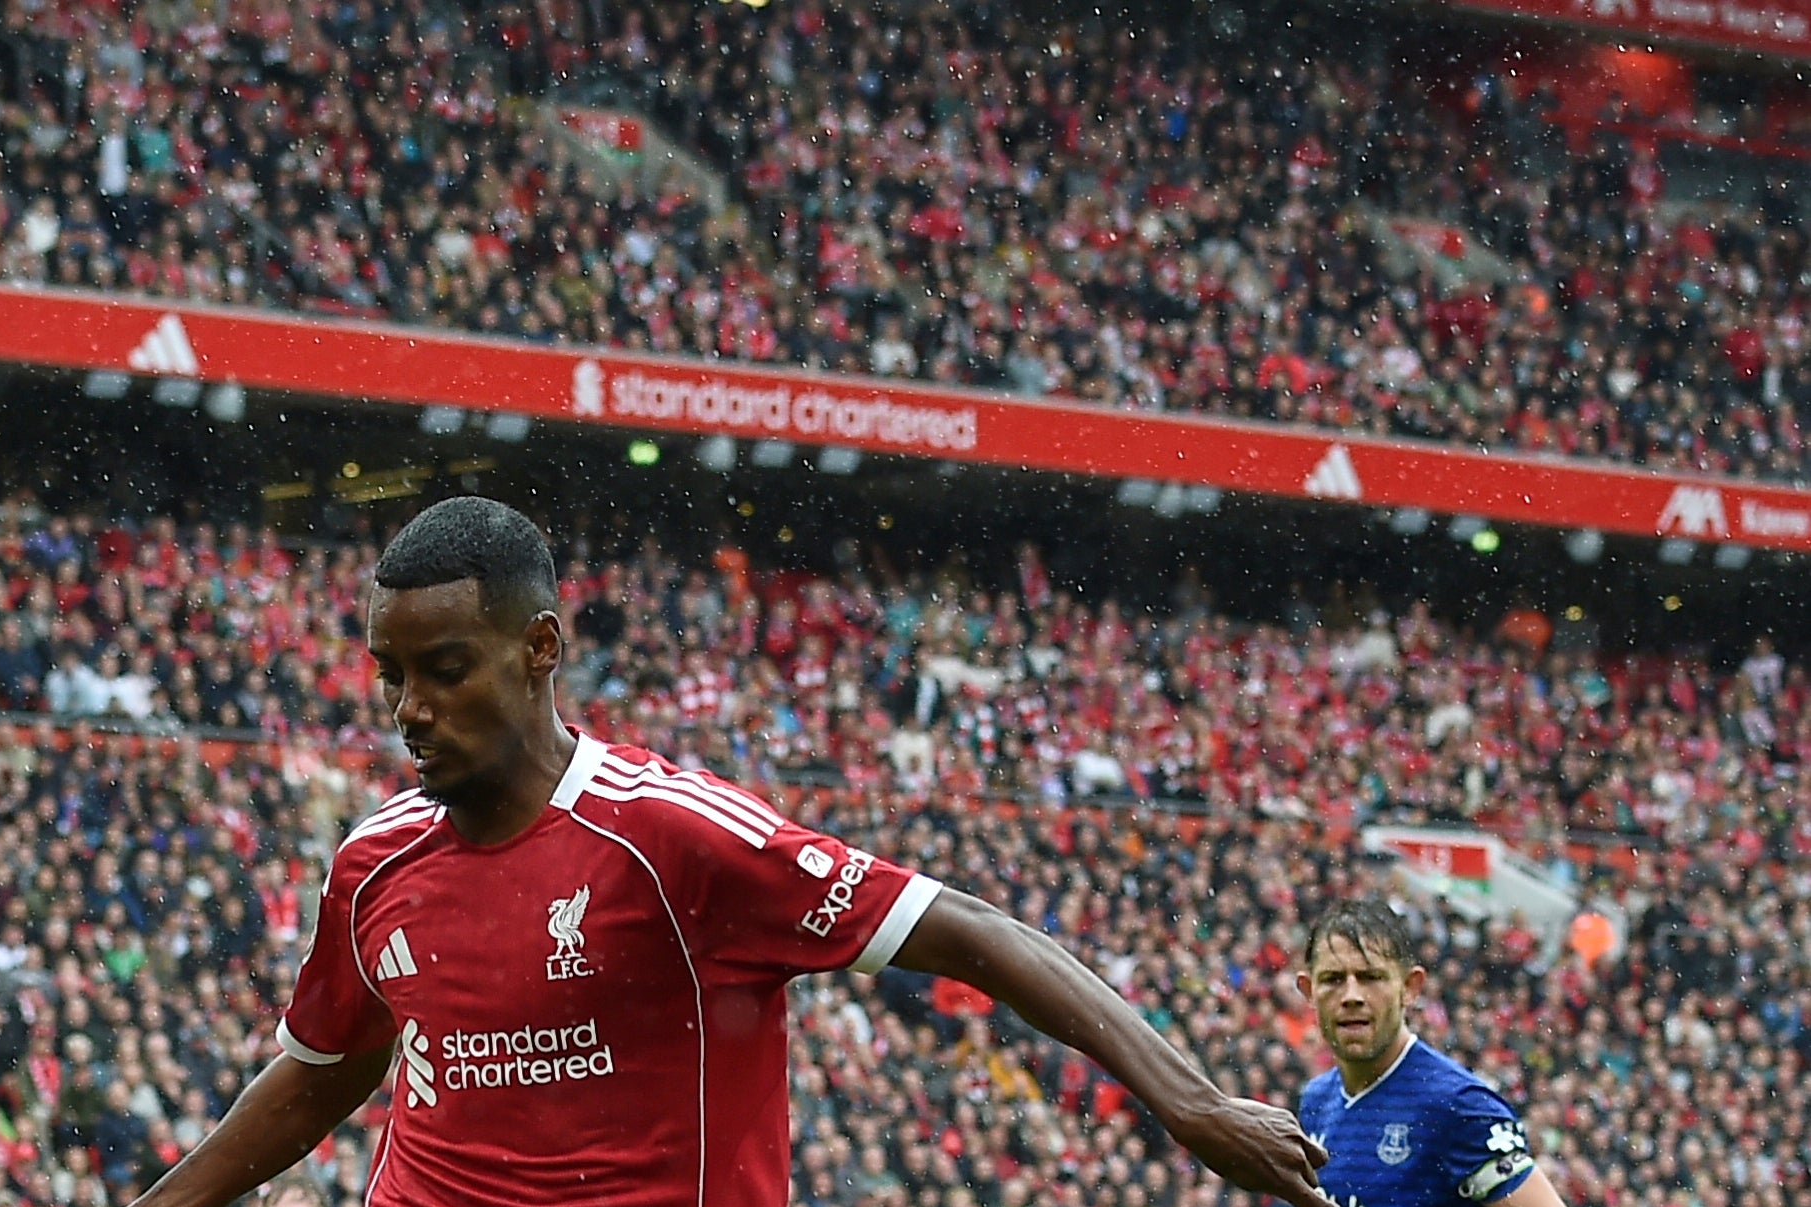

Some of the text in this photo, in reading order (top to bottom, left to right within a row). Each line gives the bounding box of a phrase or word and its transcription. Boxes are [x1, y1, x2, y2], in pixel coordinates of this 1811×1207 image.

[611, 371, 978, 451] standard chartered
[441, 1018, 599, 1061] standard
[444, 1044, 615, 1091] chartered
